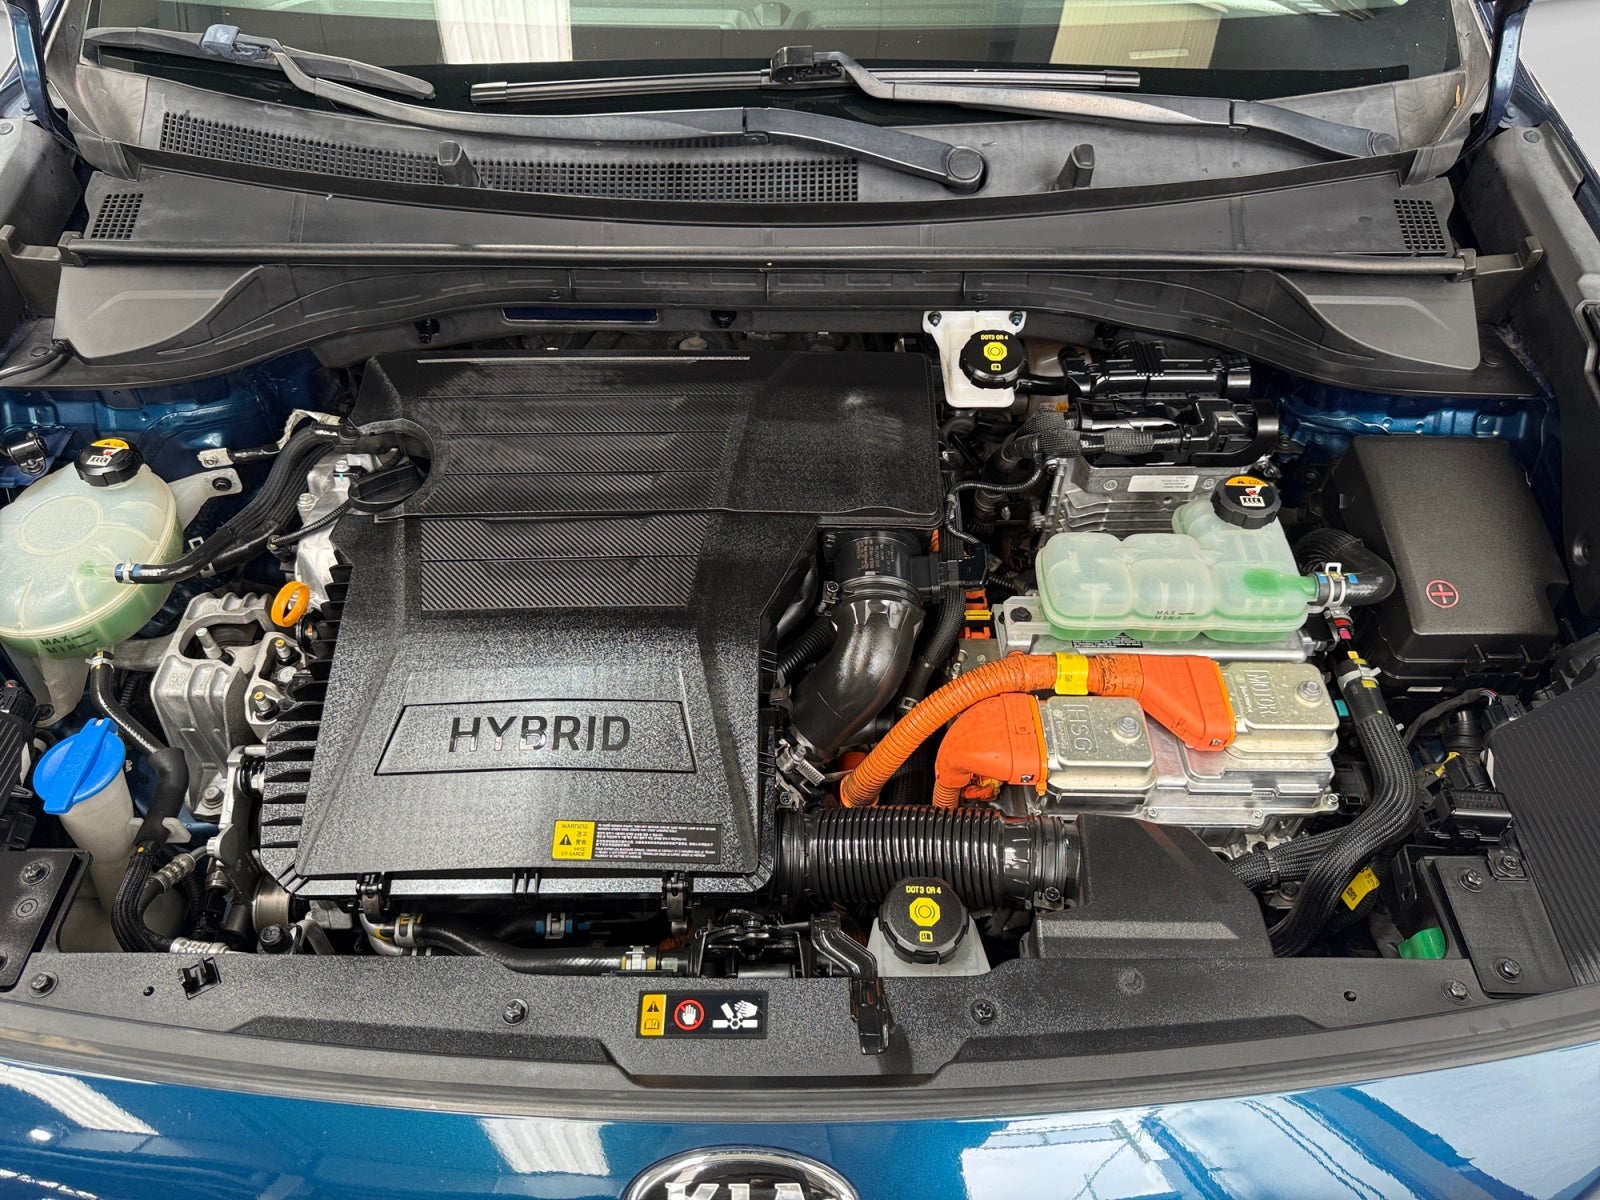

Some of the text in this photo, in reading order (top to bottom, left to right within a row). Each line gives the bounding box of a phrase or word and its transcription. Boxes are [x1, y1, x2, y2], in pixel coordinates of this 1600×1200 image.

[39, 635, 70, 646] MAX
[46, 643, 76, 654] MIN
[1247, 673, 1280, 715] MOTOR
[449, 715, 631, 753] HYBRID
[1066, 709, 1093, 751] HSG
[905, 885, 942, 895] DOT3 OR 4
